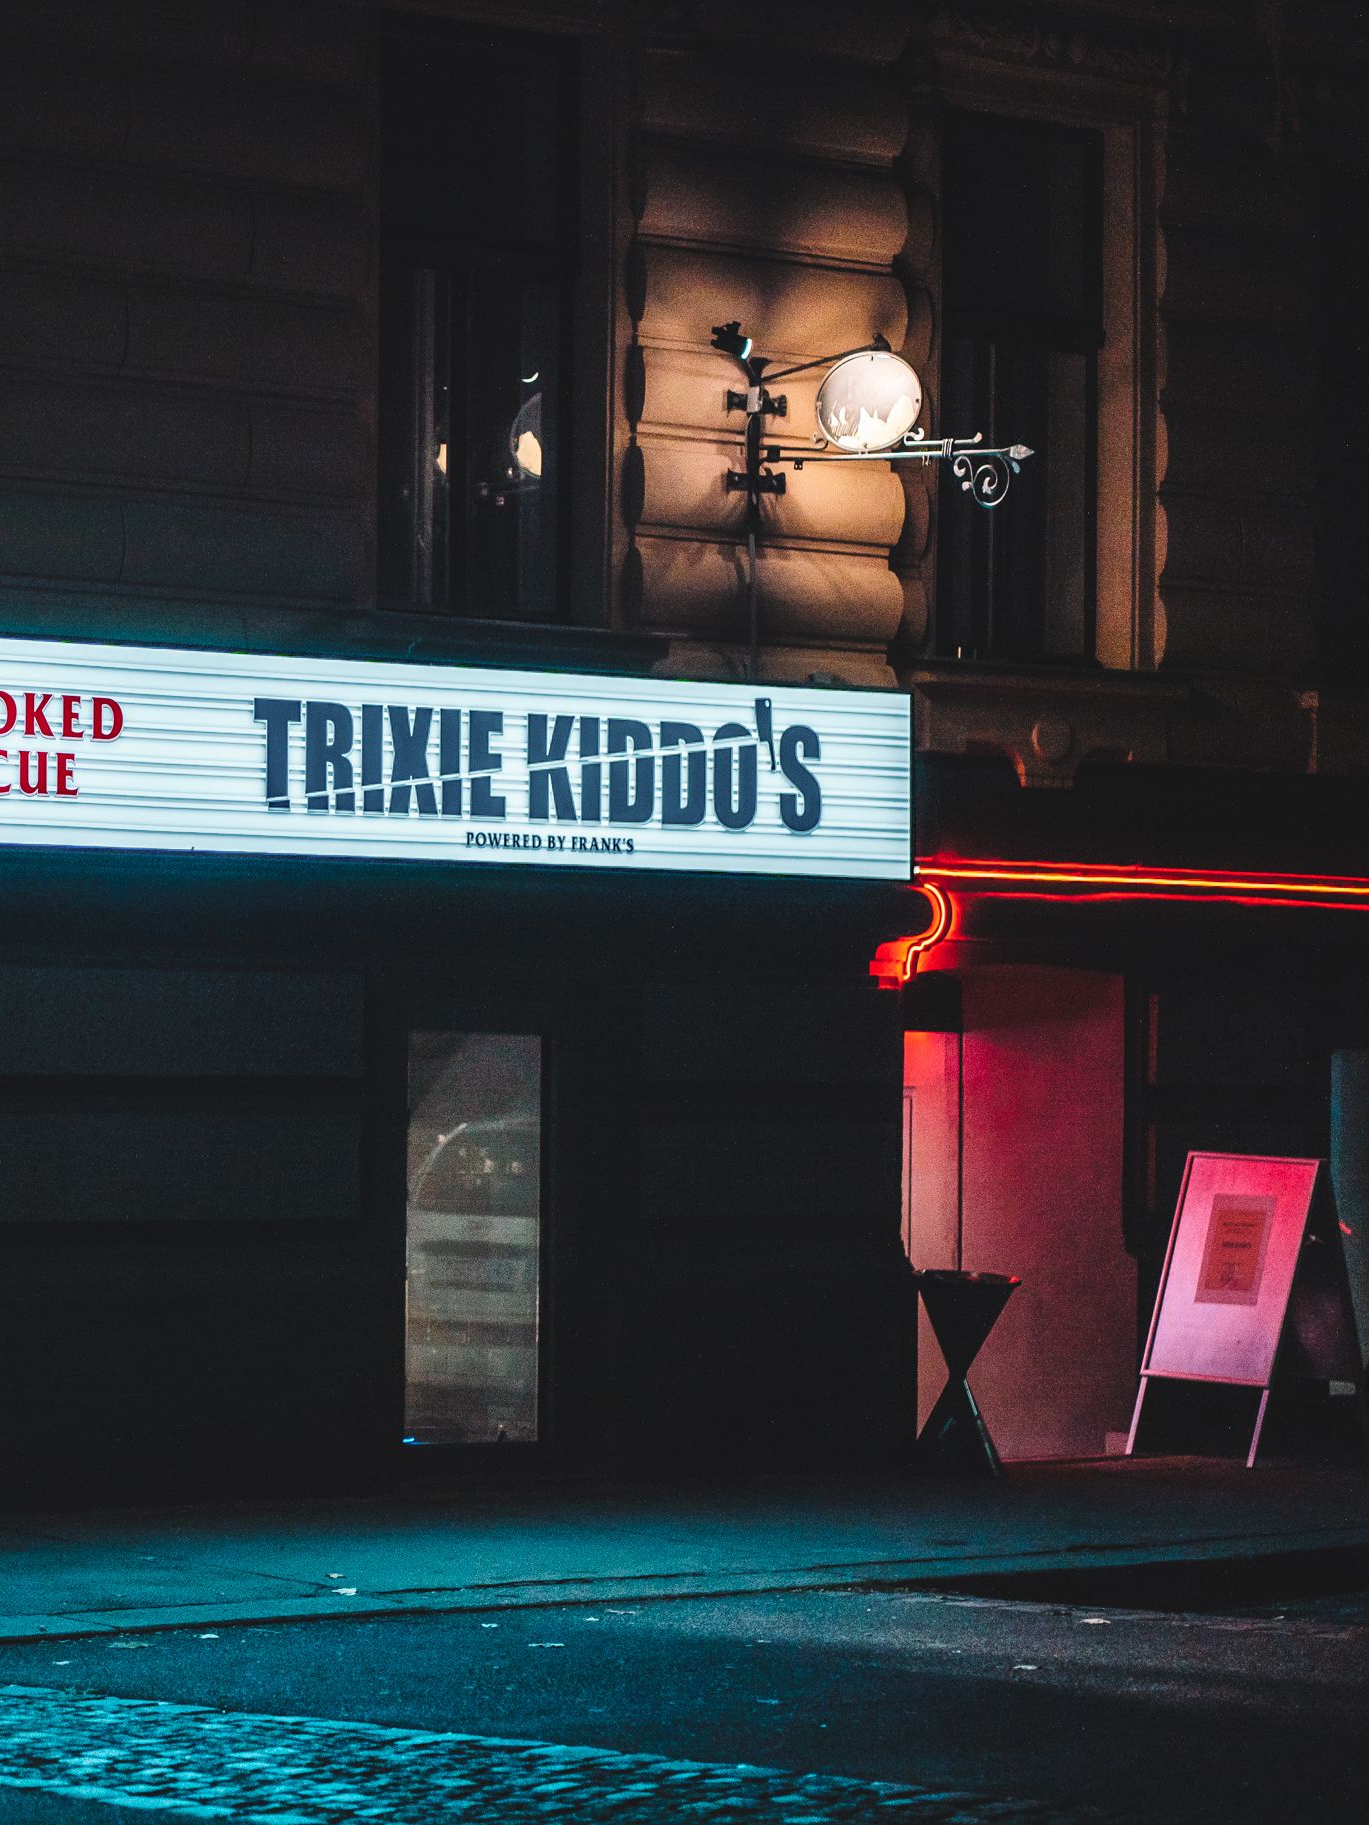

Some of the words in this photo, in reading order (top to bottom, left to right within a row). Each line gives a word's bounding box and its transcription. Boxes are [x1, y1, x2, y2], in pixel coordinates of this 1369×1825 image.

[253, 697, 506, 818] TRIXIE
[527, 697, 821, 832] KIDDO'S
[466, 831, 542, 850] POWERED
[547, 834, 566, 850] BY
[571, 836, 635, 853] FRANK'S
